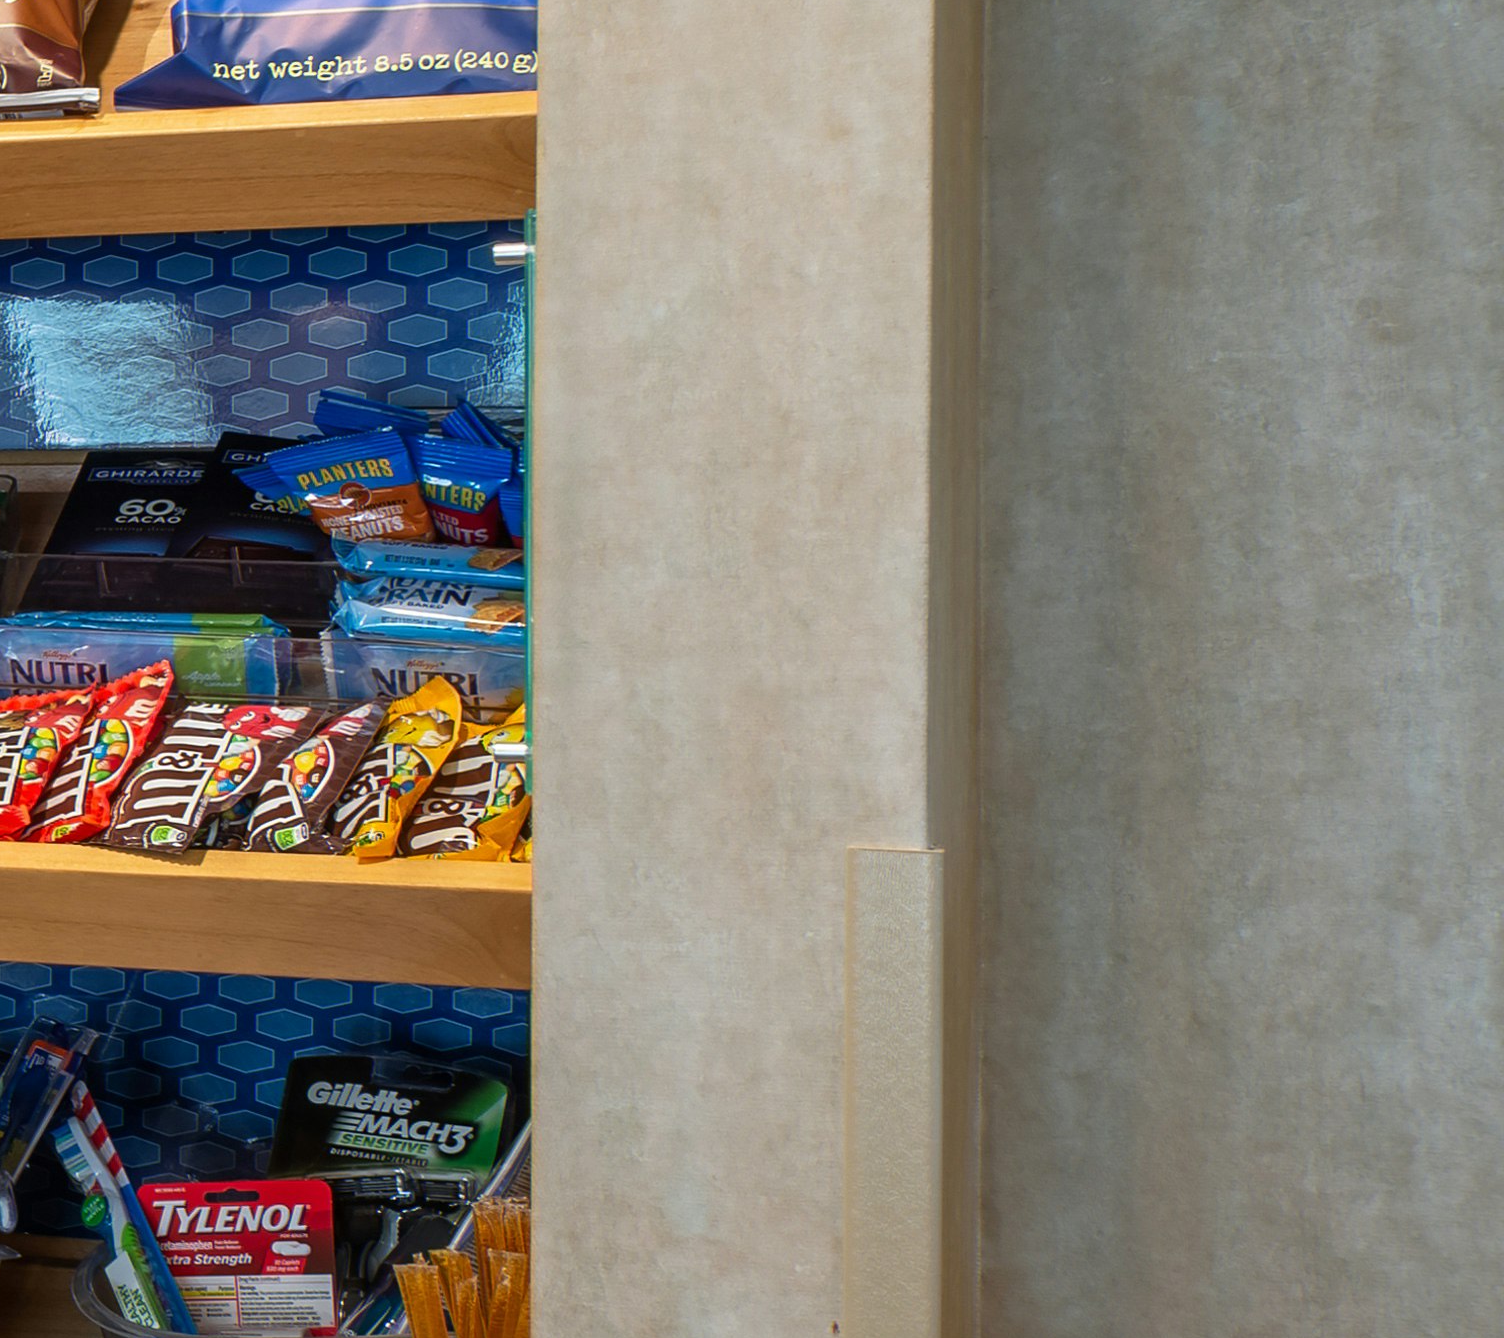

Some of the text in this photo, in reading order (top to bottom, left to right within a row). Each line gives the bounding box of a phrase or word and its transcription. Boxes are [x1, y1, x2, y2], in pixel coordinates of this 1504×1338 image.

[212, 48, 509, 82] net weight 8.5 oz (240
[298, 458, 395, 491] PLANTERS
[115, 515, 182, 525] CACAO
[9, 657, 109, 687] NUTRI
[307, 1081, 413, 1115] Gillette
[340, 1133, 429, 1155] SENSITIVE
[356, 1113, 475, 1155] MACH3
[151, 1199, 310, 1238] TYLENOL
[195, 1251, 253, 1268] Strength
